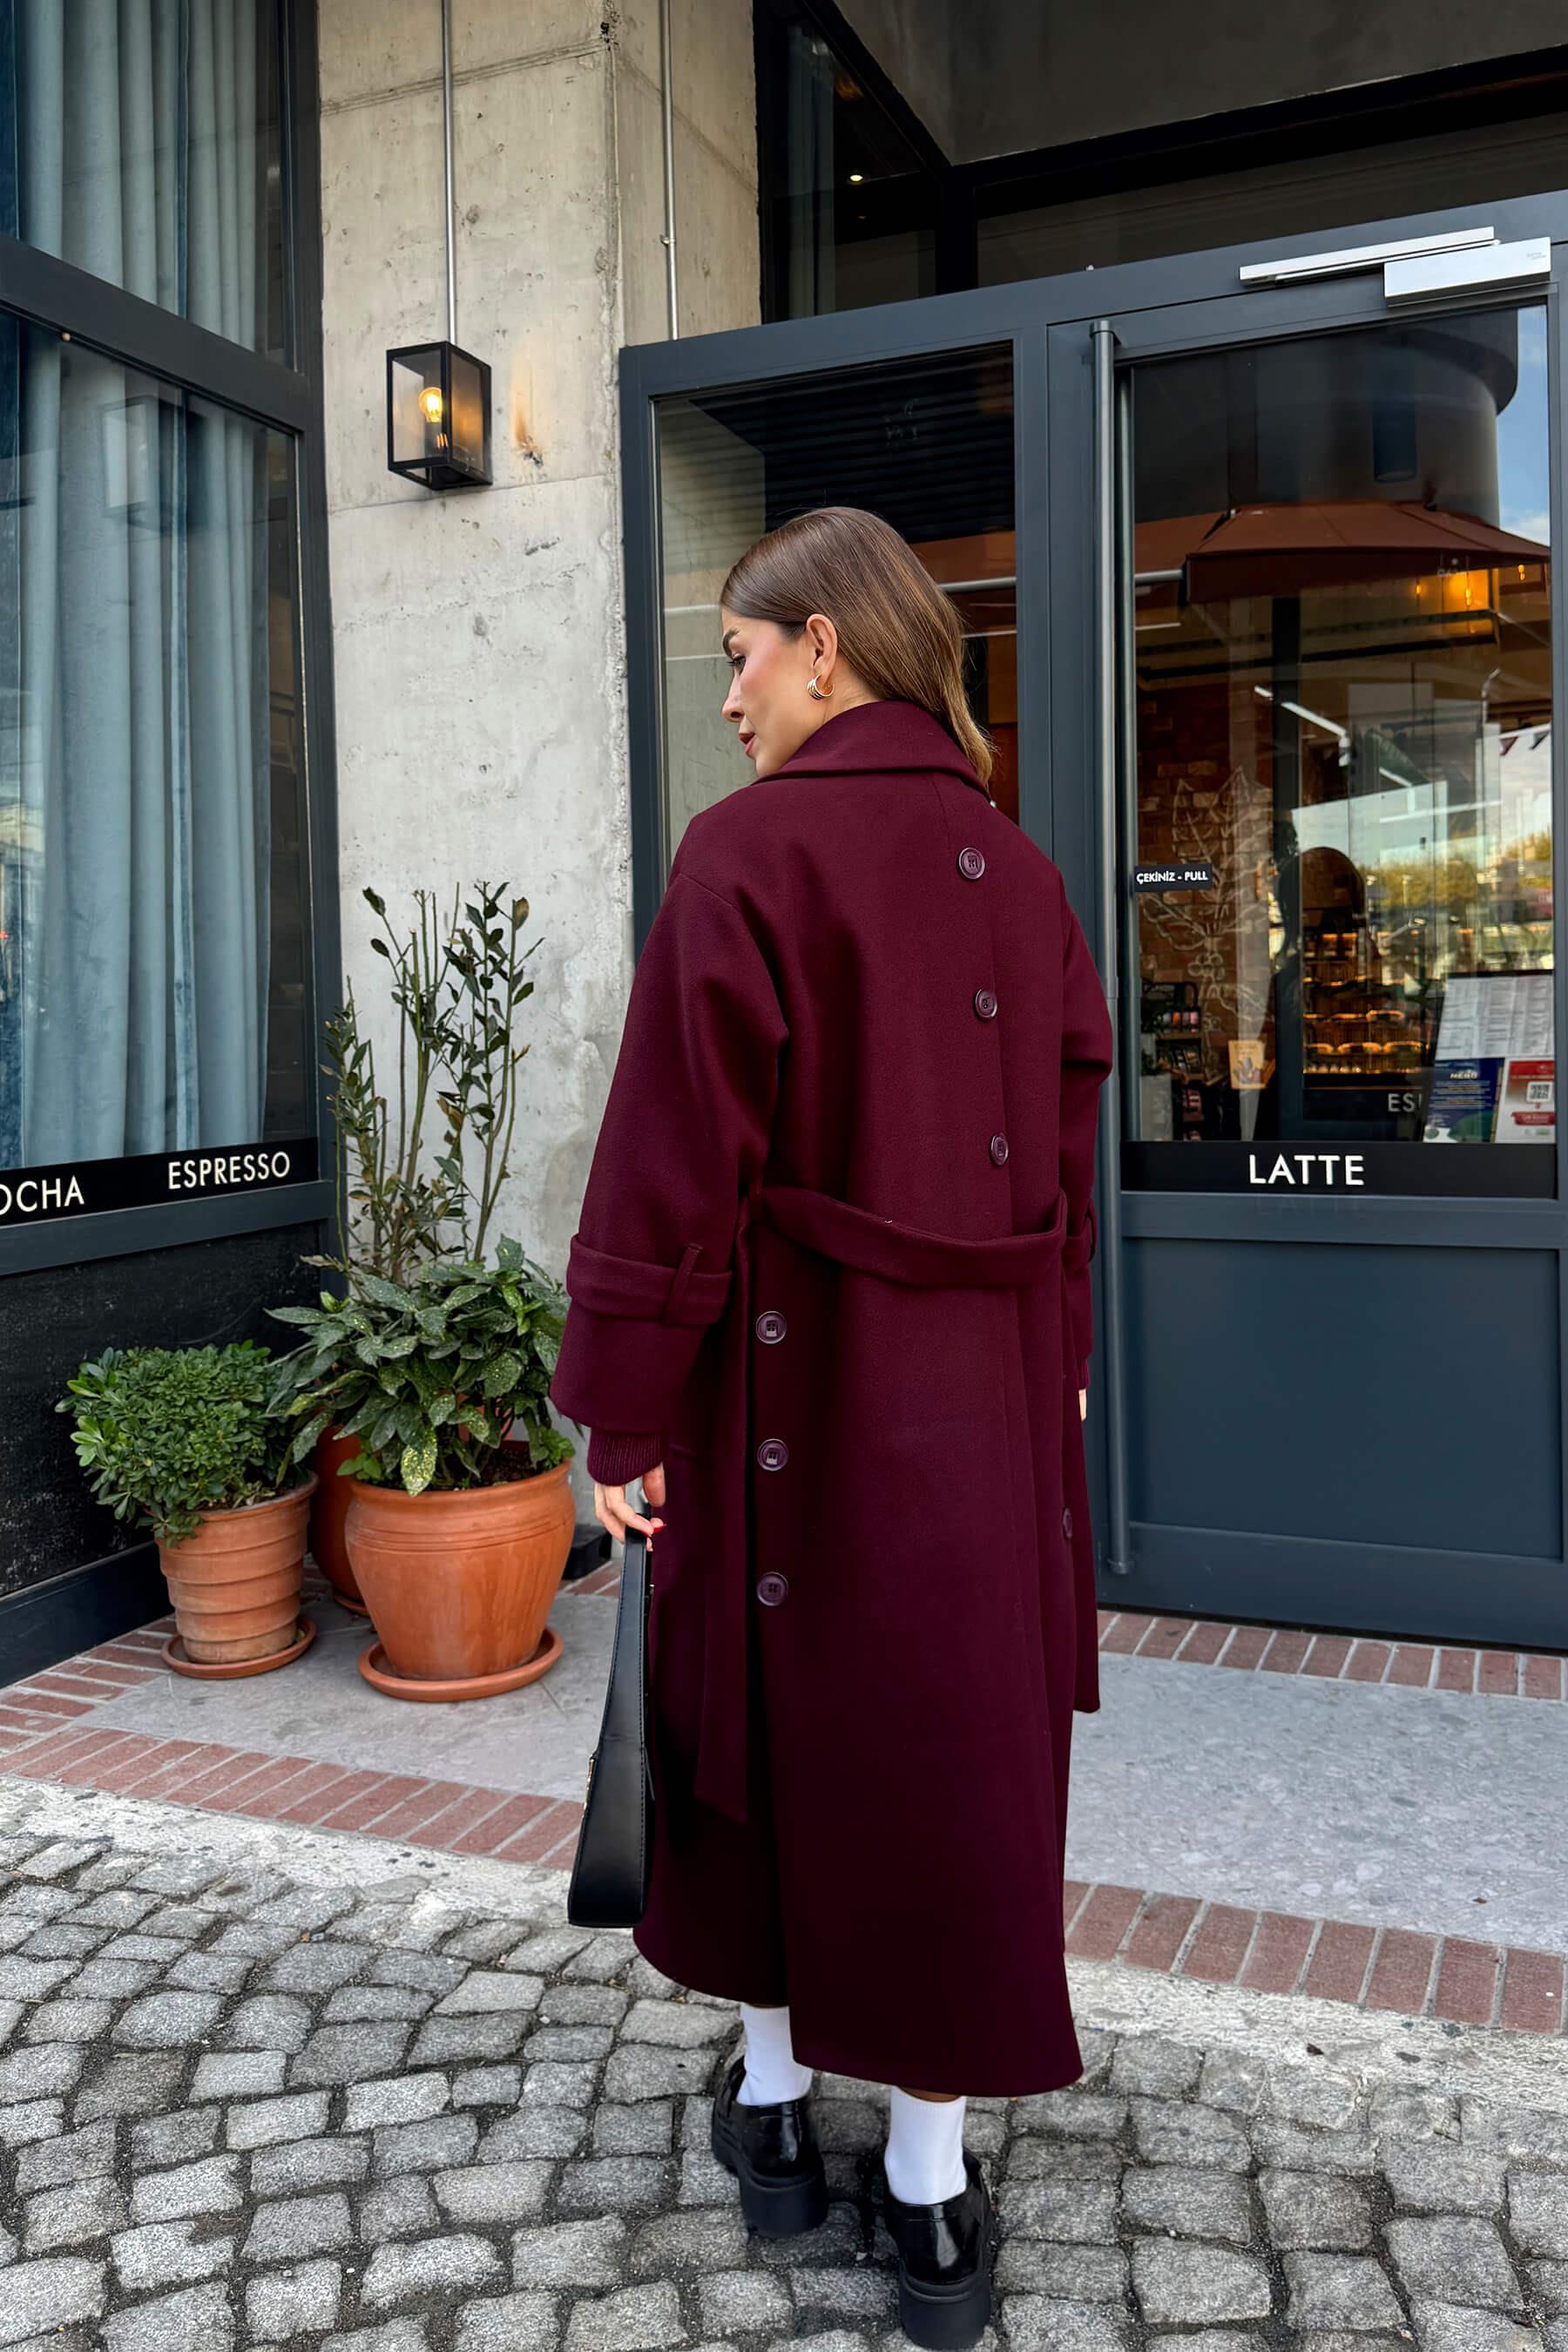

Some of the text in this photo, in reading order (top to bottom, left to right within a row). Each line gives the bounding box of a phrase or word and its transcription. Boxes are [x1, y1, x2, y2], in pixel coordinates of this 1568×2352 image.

[1136, 870, 1176, 885] ÇEKİNİZ
[1184, 870, 1209, 882] PULL
[1388, 1092, 1423, 1112] ES
[167, 1151, 291, 1190] ESPRESSO
[1248, 1152, 1365, 1186] LATTE
